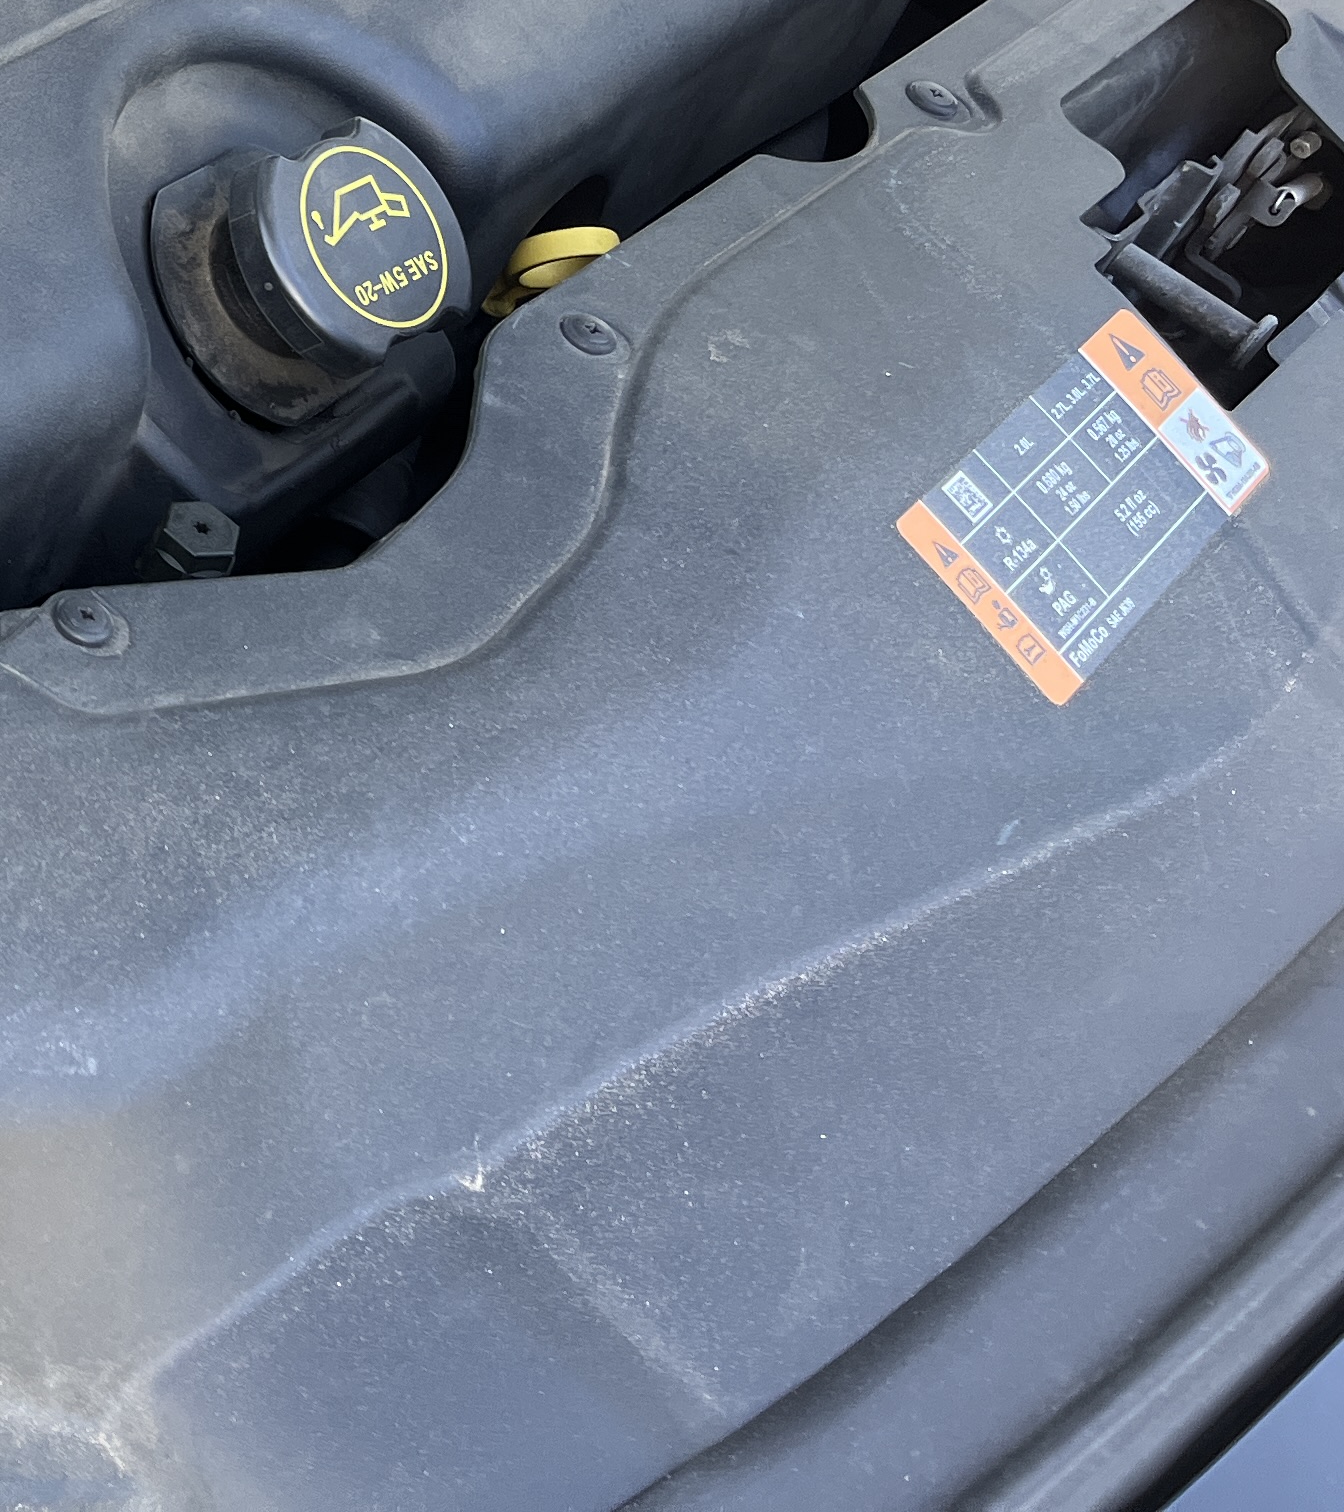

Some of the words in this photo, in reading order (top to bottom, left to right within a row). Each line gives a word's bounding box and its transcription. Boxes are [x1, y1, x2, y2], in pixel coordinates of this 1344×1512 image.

[403, 250, 438, 280] SAE
[354, 265, 408, 305] 5W-20
[1080, 372, 1100, 389] 3.7L
[1086, 415, 1111, 440] 0.567
[1102, 409, 1122, 424] kg
[1114, 428, 1126, 440] oz
[1013, 436, 1035, 455] 2.0L
[1113, 444, 1130, 462] 1.25
[1052, 461, 1072, 476] kg
[1055, 486, 1069, 501] 24
[1064, 480, 1077, 492] oz
[1063, 497, 1081, 515] 1.50
[1075, 490, 1090, 505] lbs
[1113, 503, 1131, 522] 5.2
[1124, 496, 1137, 510] fl
[1133, 489, 1146, 503] oz
[1125, 511, 1147, 537] (155
[1143, 499, 1160, 518] cc)
[1002, 538, 1037, 571] R-134a
[1051, 590, 1078, 616] PAG
[1068, 626, 1108, 667] FoMoCo
[1105, 609, 1123, 628] SAE
